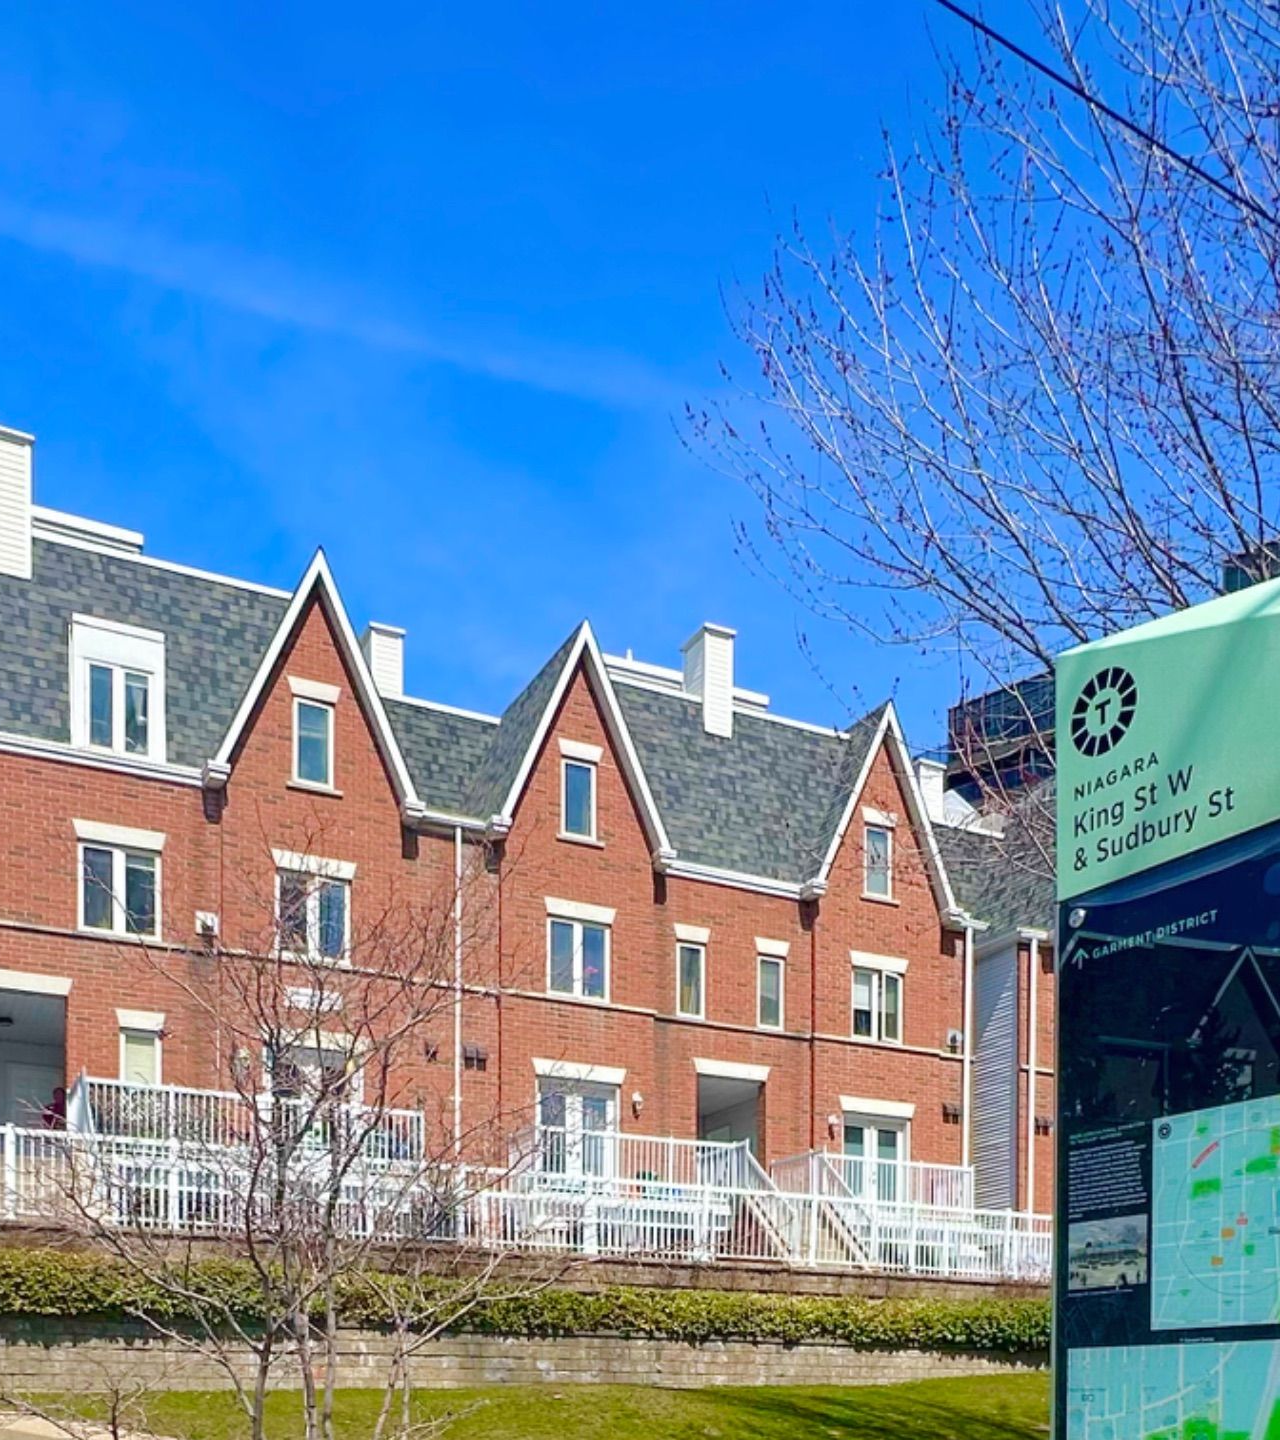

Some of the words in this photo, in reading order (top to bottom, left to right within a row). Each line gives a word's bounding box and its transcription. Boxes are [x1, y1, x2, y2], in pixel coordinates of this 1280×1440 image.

[1074, 752, 1159, 801] NIAGARA
[1074, 800, 1124, 838] King
[1134, 782, 1158, 812] St
[1168, 765, 1193, 796] W
[1074, 848, 1088, 871] &
[1097, 806, 1198, 863] Sudbury
[1208, 786, 1234, 818] St
[1093, 931, 1152, 959] GARMENT
[1156, 909, 1218, 939] DISTRICT
